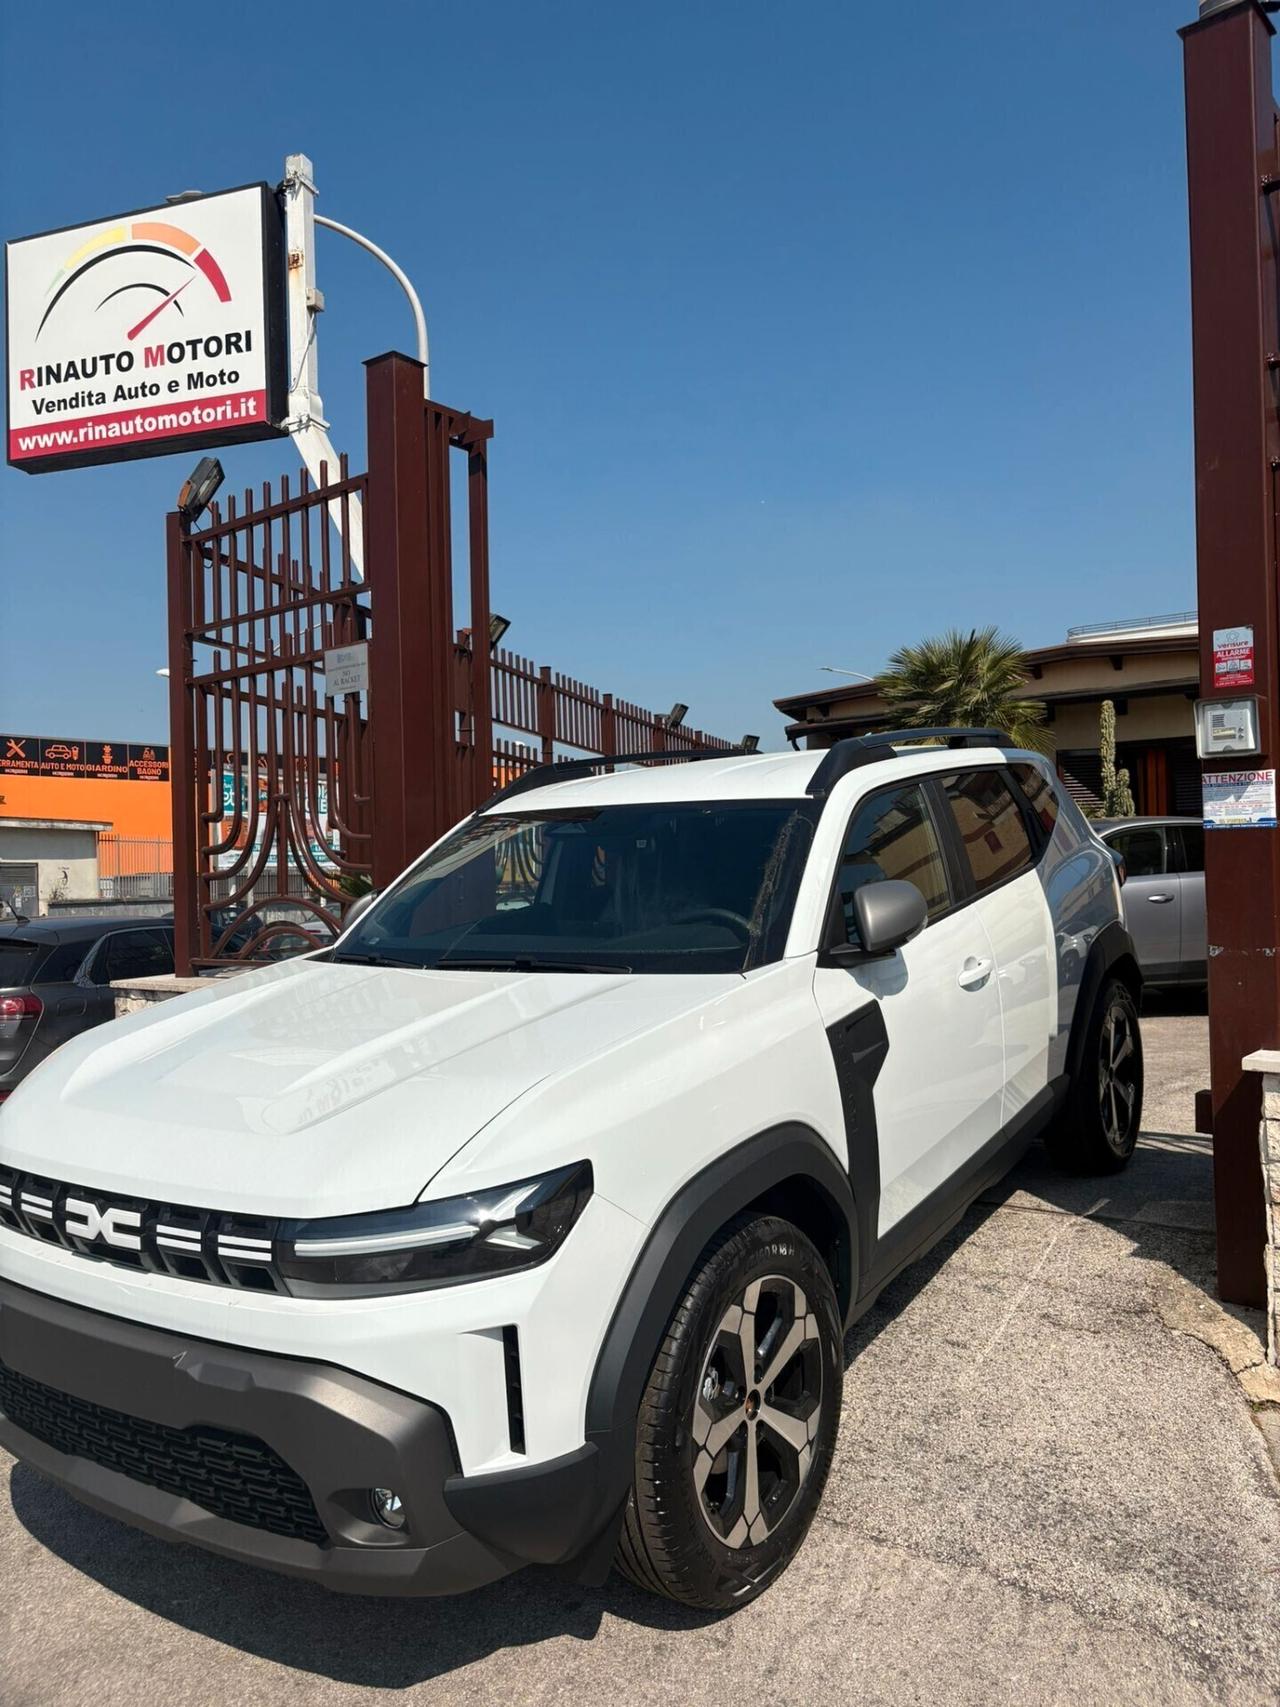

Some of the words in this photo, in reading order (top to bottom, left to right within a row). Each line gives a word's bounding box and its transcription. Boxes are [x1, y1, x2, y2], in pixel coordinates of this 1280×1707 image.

[19, 350, 134, 391] RINAUTO
[144, 330, 252, 368] MOTORI
[32, 389, 107, 415] Vendita
[113, 380, 161, 402] Auto
[168, 379, 180, 393] e
[188, 369, 240, 390] Moto
[18, 397, 257, 451] www.rinautomotori.it
[1216, 648, 1250, 658] ALLARME
[40, 762, 59, 770] AUTO
[66, 763, 85, 771] MOTO
[86, 764, 128, 773] GIARDINO
[129, 760, 169, 769] ACCESSORI
[137, 767, 162, 776] BAGNO
[1202, 771, 1273, 784] ATTENZIONE
